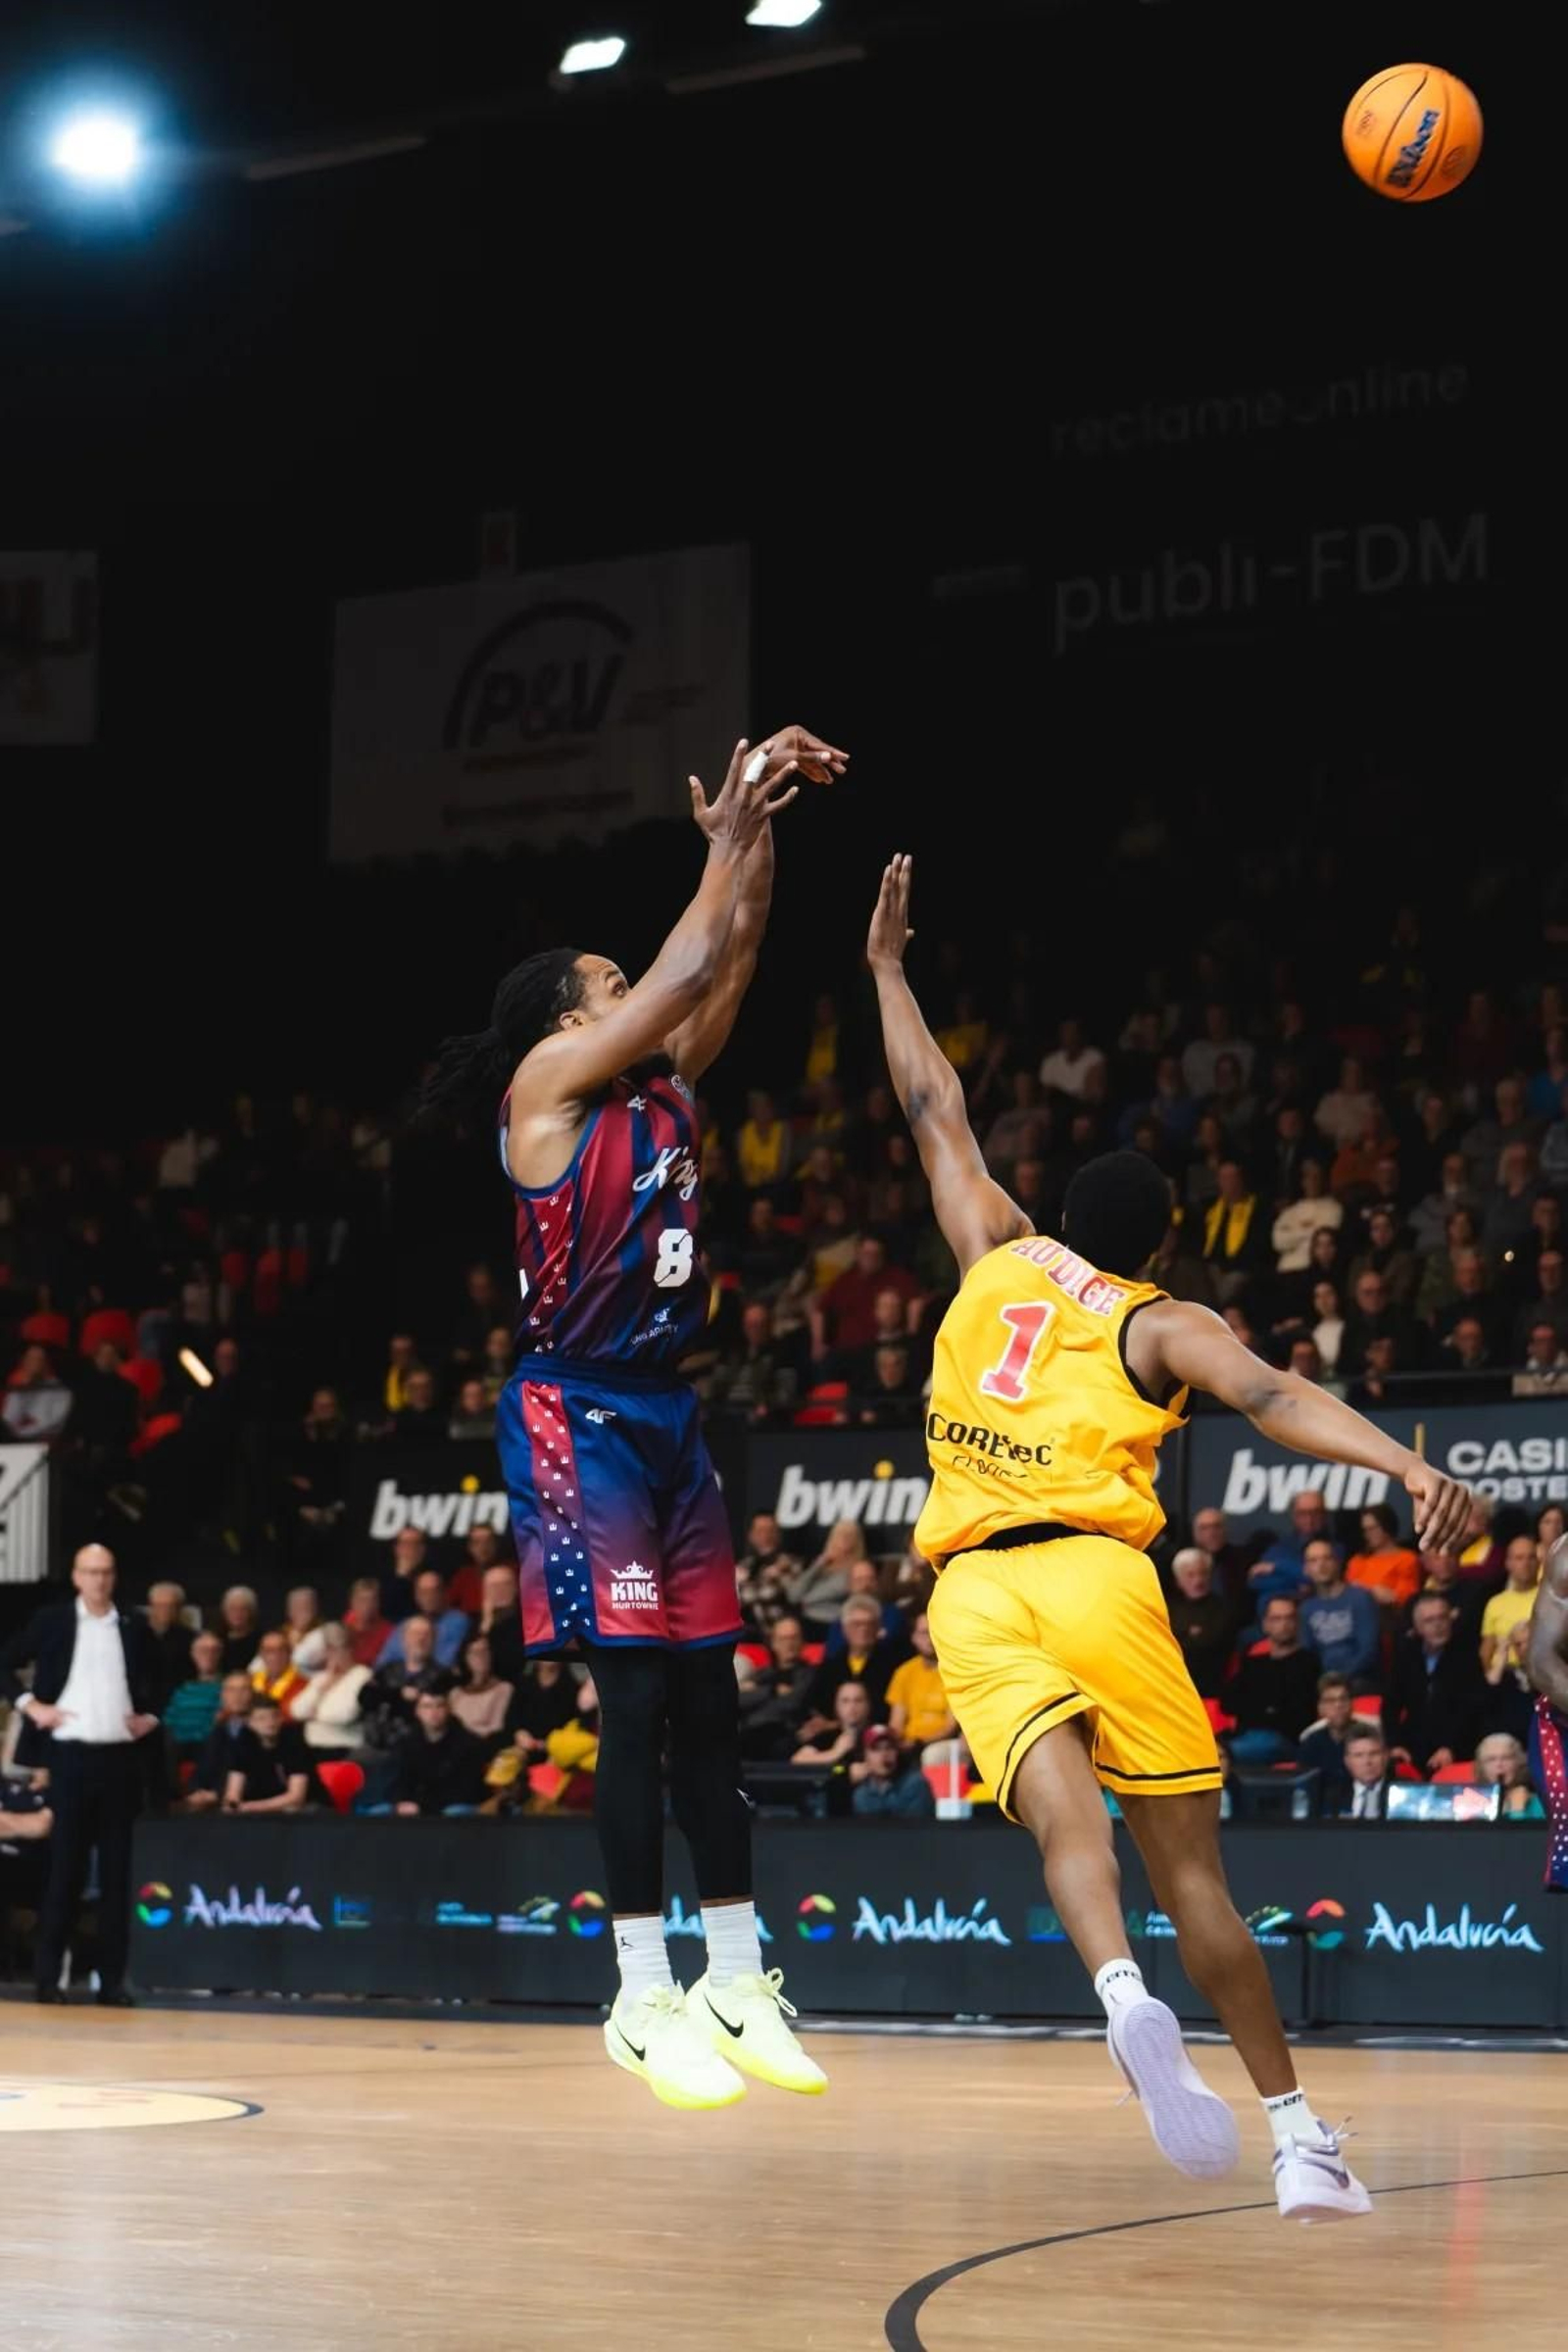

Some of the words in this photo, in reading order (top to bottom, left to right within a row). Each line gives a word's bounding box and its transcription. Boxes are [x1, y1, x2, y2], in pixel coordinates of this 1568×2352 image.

[1052, 511, 1491, 656] publi-FDM
[468, 653, 626, 747] P&V
[654, 1228, 694, 1289] 8
[1009, 1237, 1127, 1317] AUDIGE
[979, 1299, 1056, 1402] 1
[369, 1475, 509, 1541] bwin
[775, 1459, 928, 1529] bwin
[1222, 1447, 1391, 1516] bwin
[611, 1582, 659, 1601] KING
[1365, 1901, 1544, 1953] Andalucía
